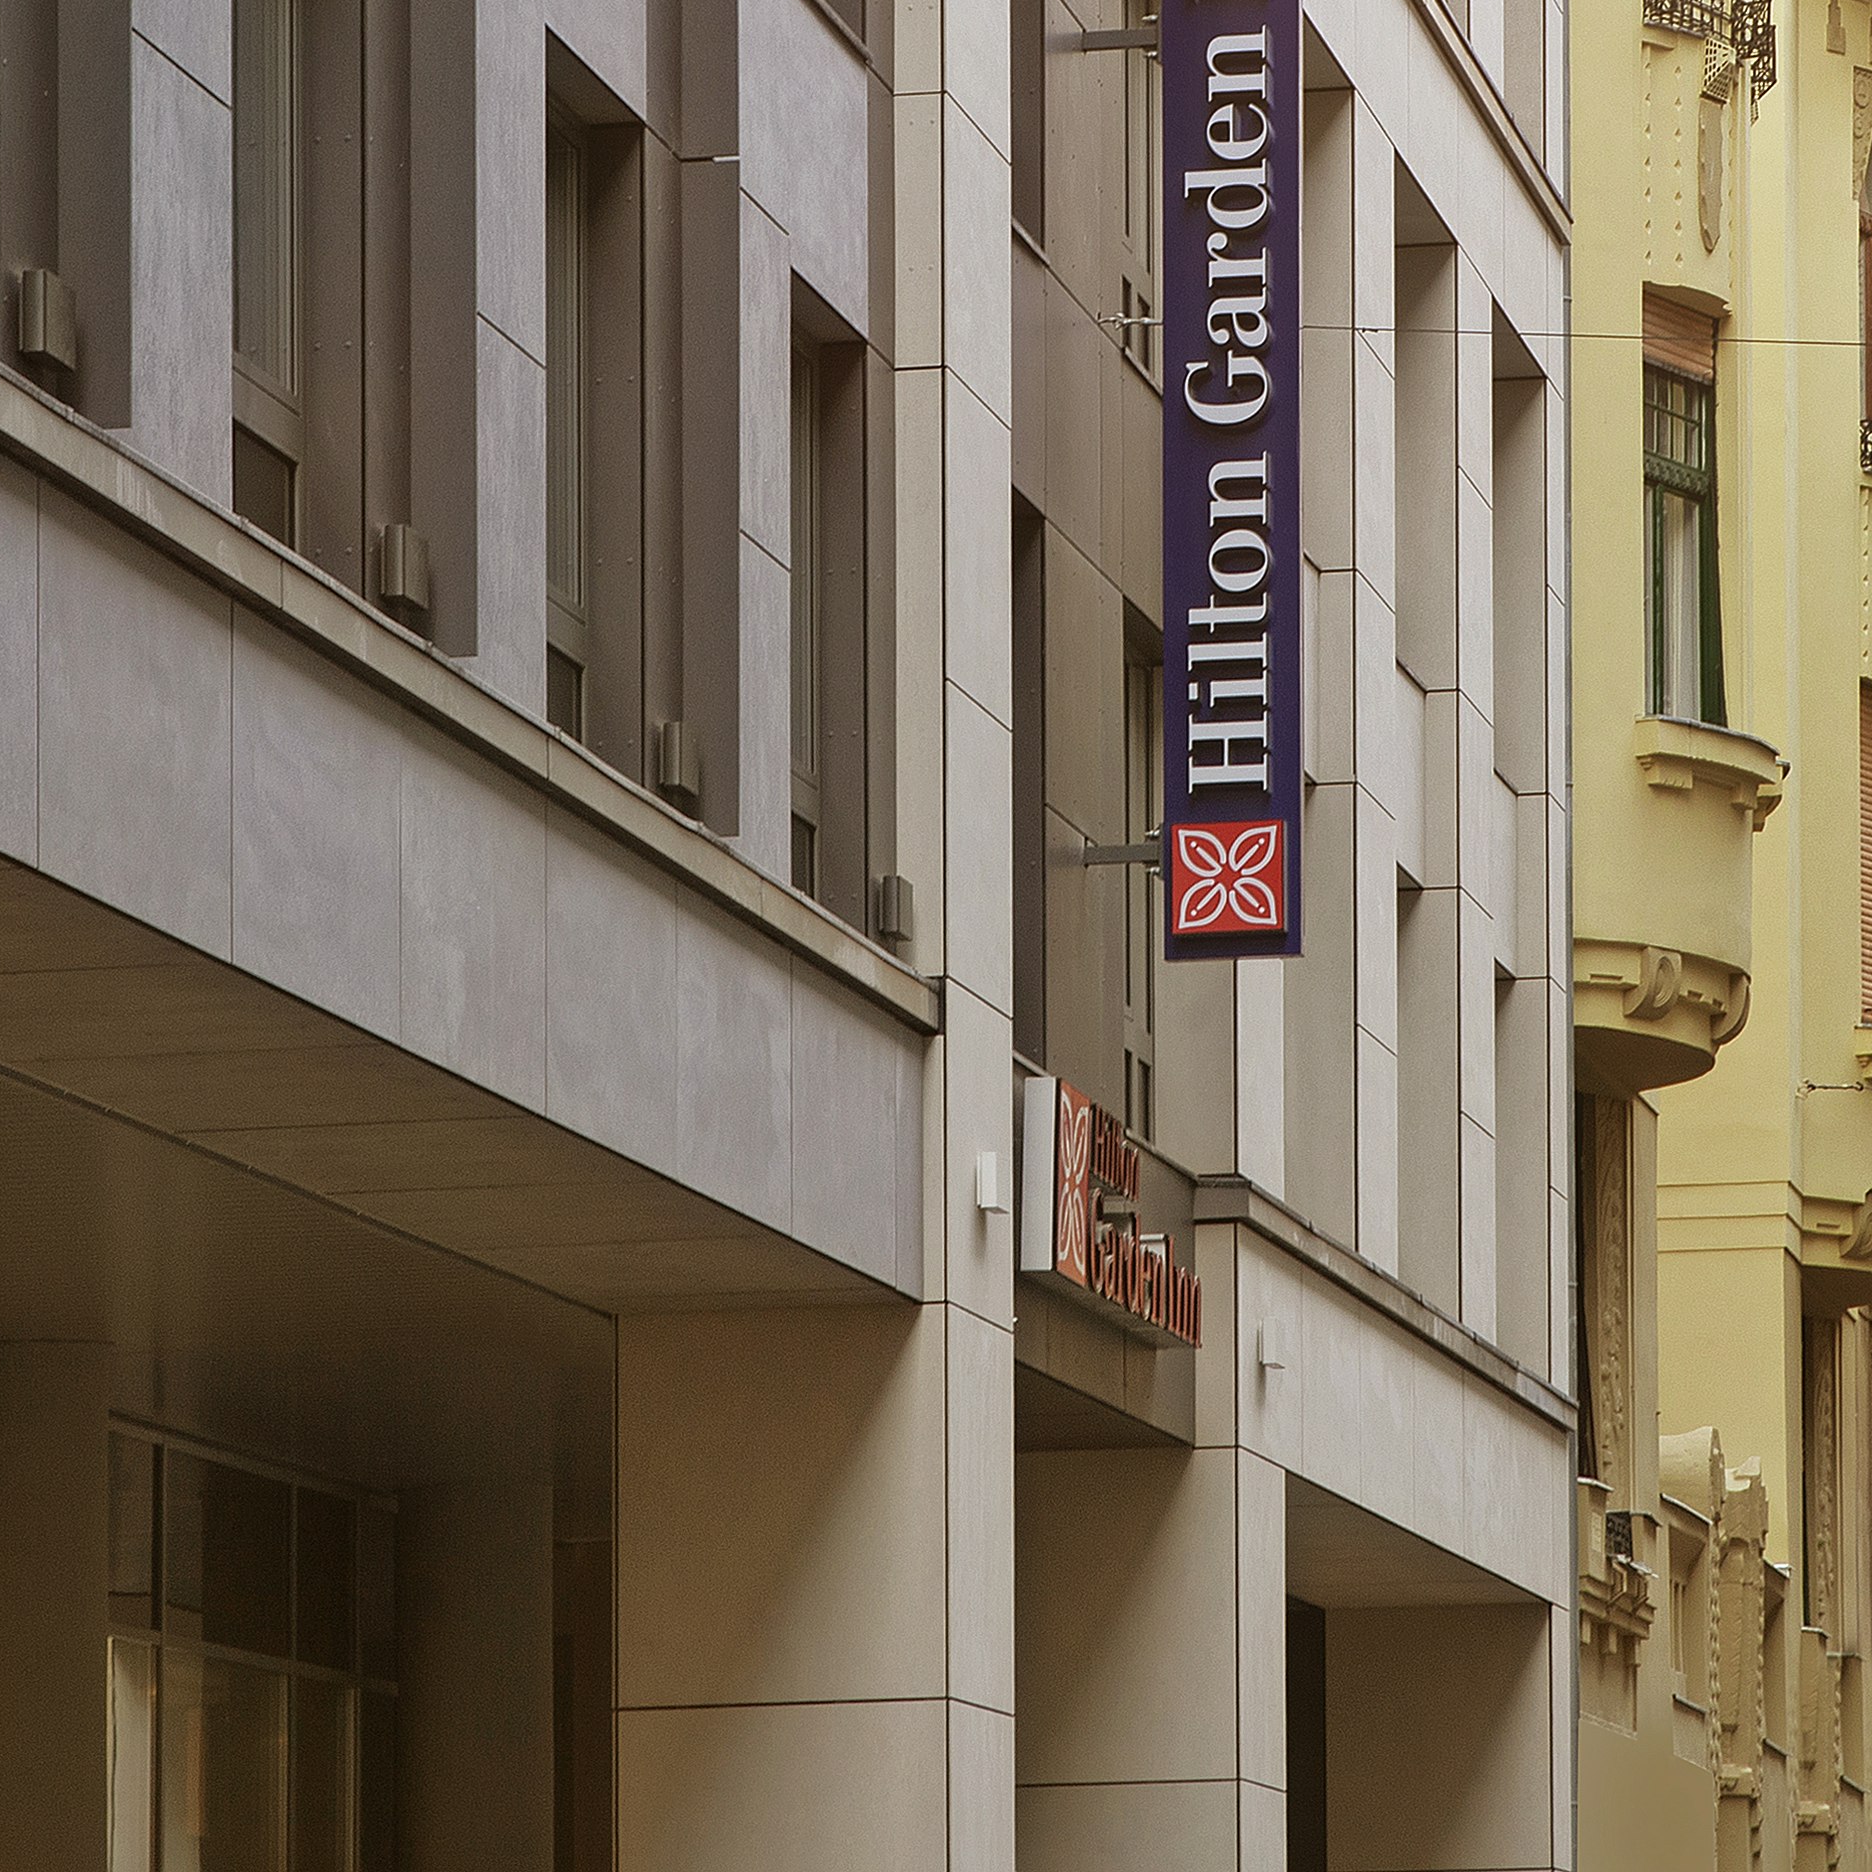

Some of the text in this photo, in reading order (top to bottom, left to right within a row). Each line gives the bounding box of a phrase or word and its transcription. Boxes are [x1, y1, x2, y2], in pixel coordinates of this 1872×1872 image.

[1184, 24, 1269, 426] Garden
[1187, 449, 1269, 795] Hilton
[1090, 1187, 1166, 1329] Garden
